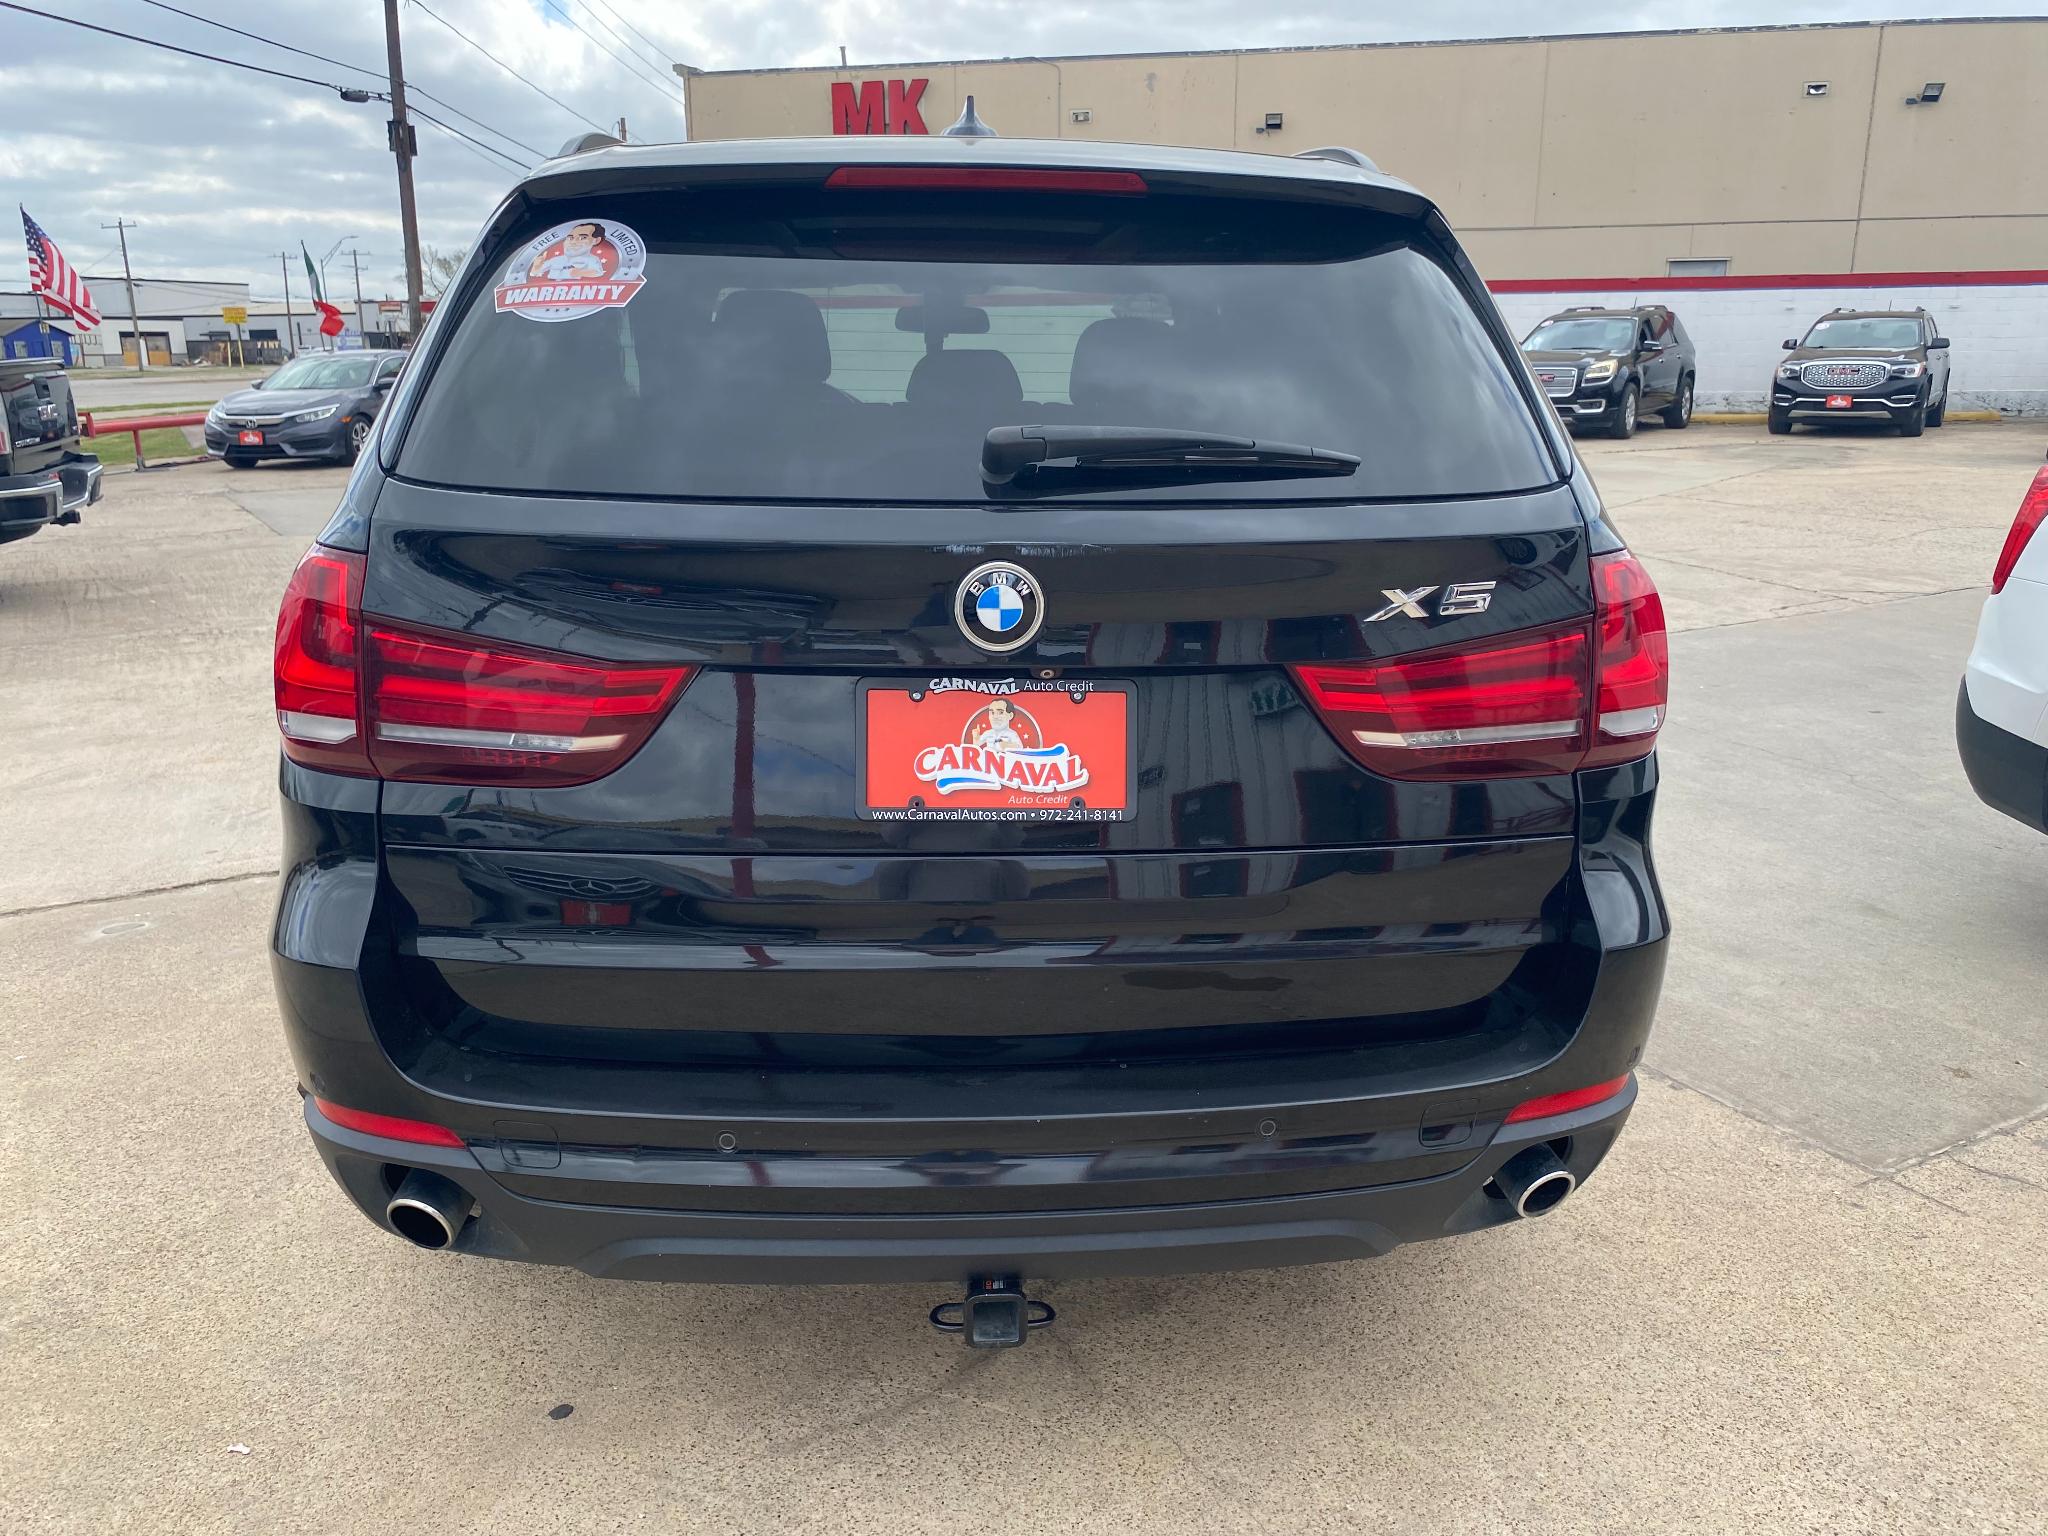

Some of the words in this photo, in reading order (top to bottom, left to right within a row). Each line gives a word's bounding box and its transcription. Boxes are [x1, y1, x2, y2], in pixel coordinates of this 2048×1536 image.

[831, 78, 929, 135] MK
[532, 231, 561, 252] FREE
[610, 228, 638, 256] LIMITED
[504, 284, 626, 305] WARRANTY
[968, 571, 1032, 598] BMW
[1362, 580, 1497, 622] X5
[929, 677, 1020, 695] CARNAVAL
[1023, 680, 1053, 692] Auto
[1056, 680, 1094, 692] Credit
[914, 744, 1089, 792] CARNAVAL
[1008, 794, 1034, 804] Auto
[1036, 794, 1069, 804] Credit
[872, 808, 1027, 821] www.CarnavalAutos.com
[1039, 809, 1123, 821] 972-241-8141
